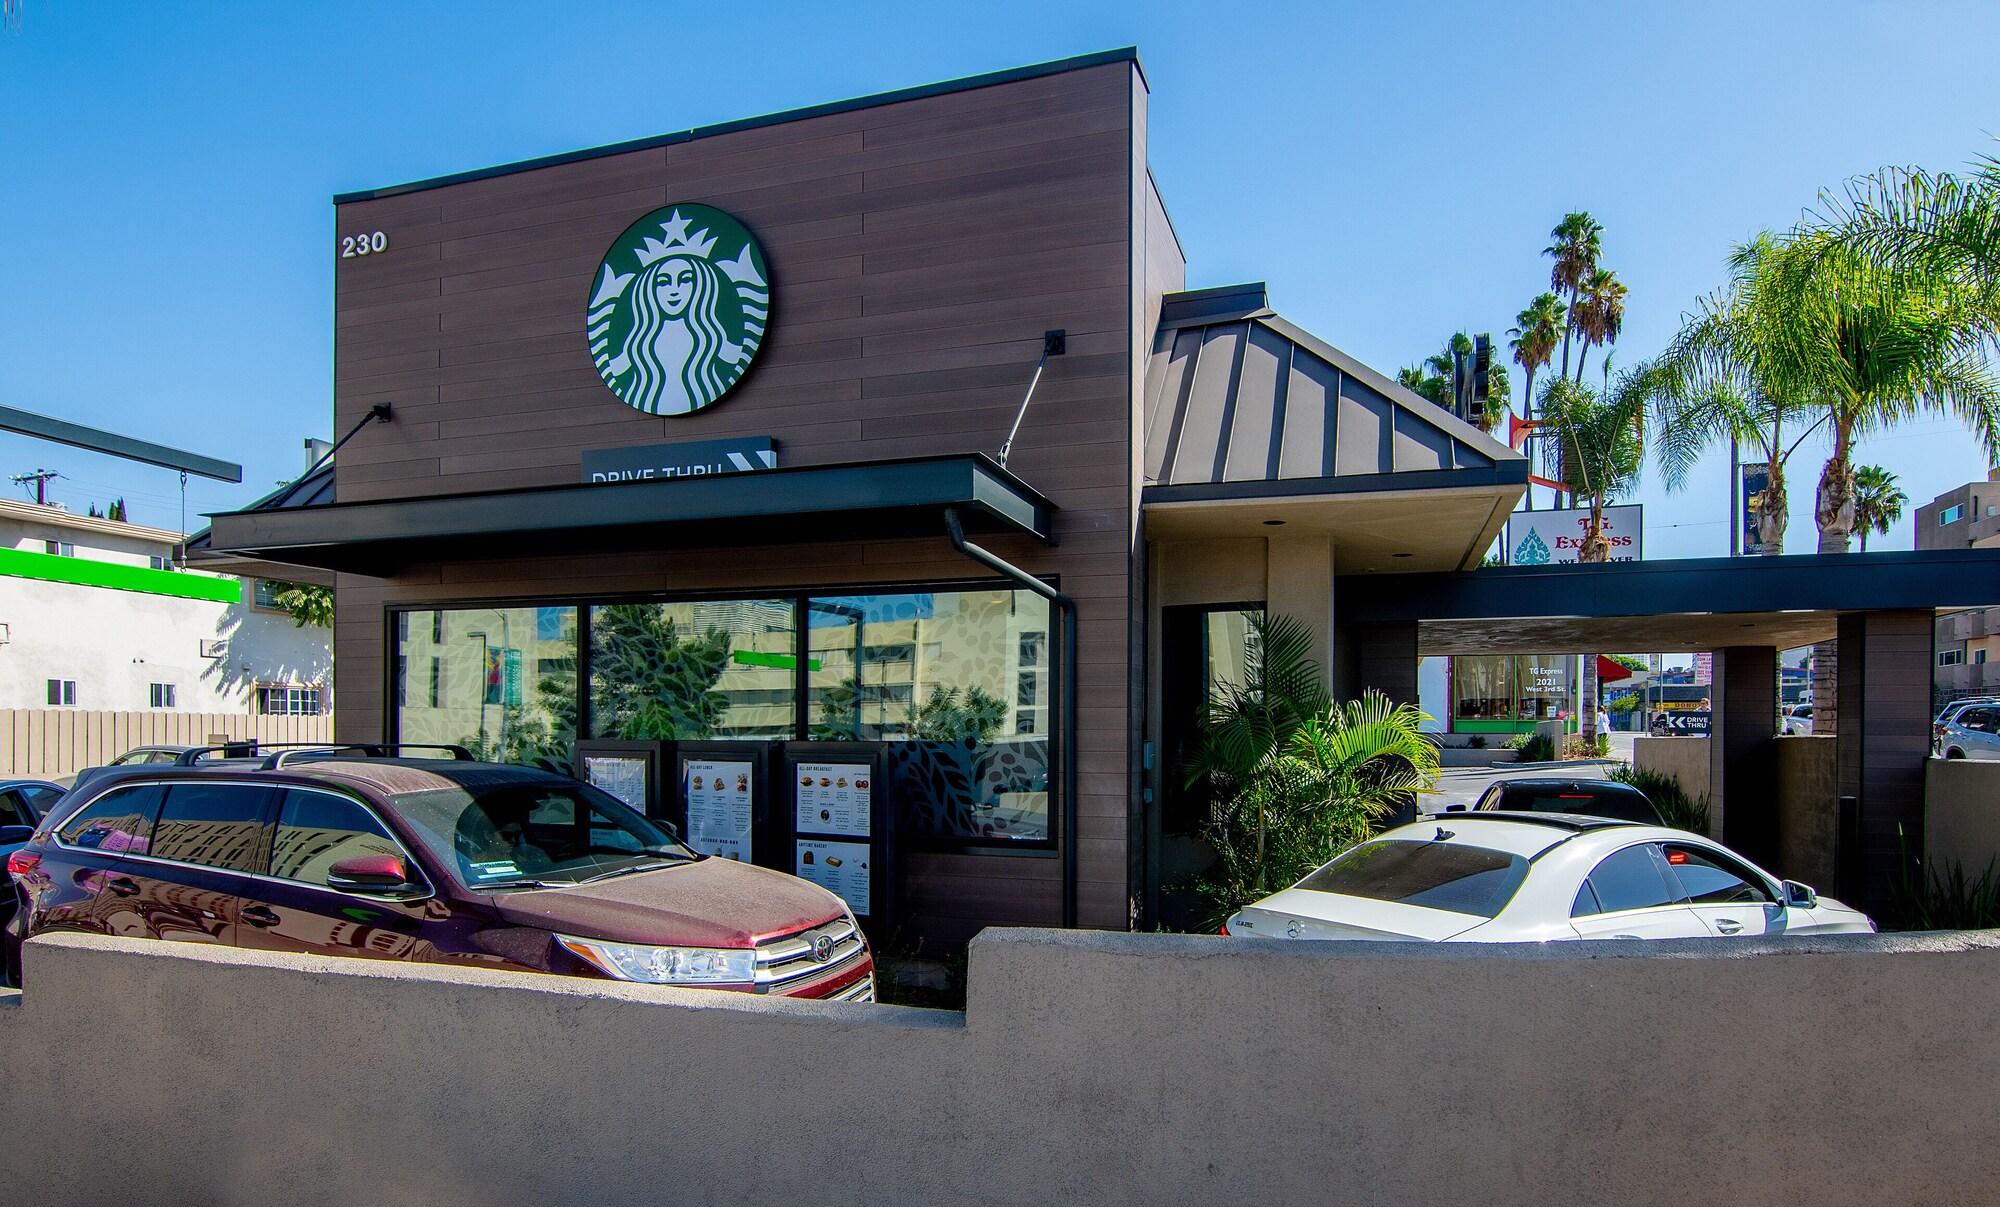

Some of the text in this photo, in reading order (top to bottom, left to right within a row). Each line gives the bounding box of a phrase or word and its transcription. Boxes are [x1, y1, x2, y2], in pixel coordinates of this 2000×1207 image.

[342, 231, 388, 258] 230
[592, 463, 722, 483] DRIVE THRU
[1555, 535, 1632, 550] Exss
[1529, 667, 1563, 676] TG Express
[1536, 678, 1556, 686] 2021
